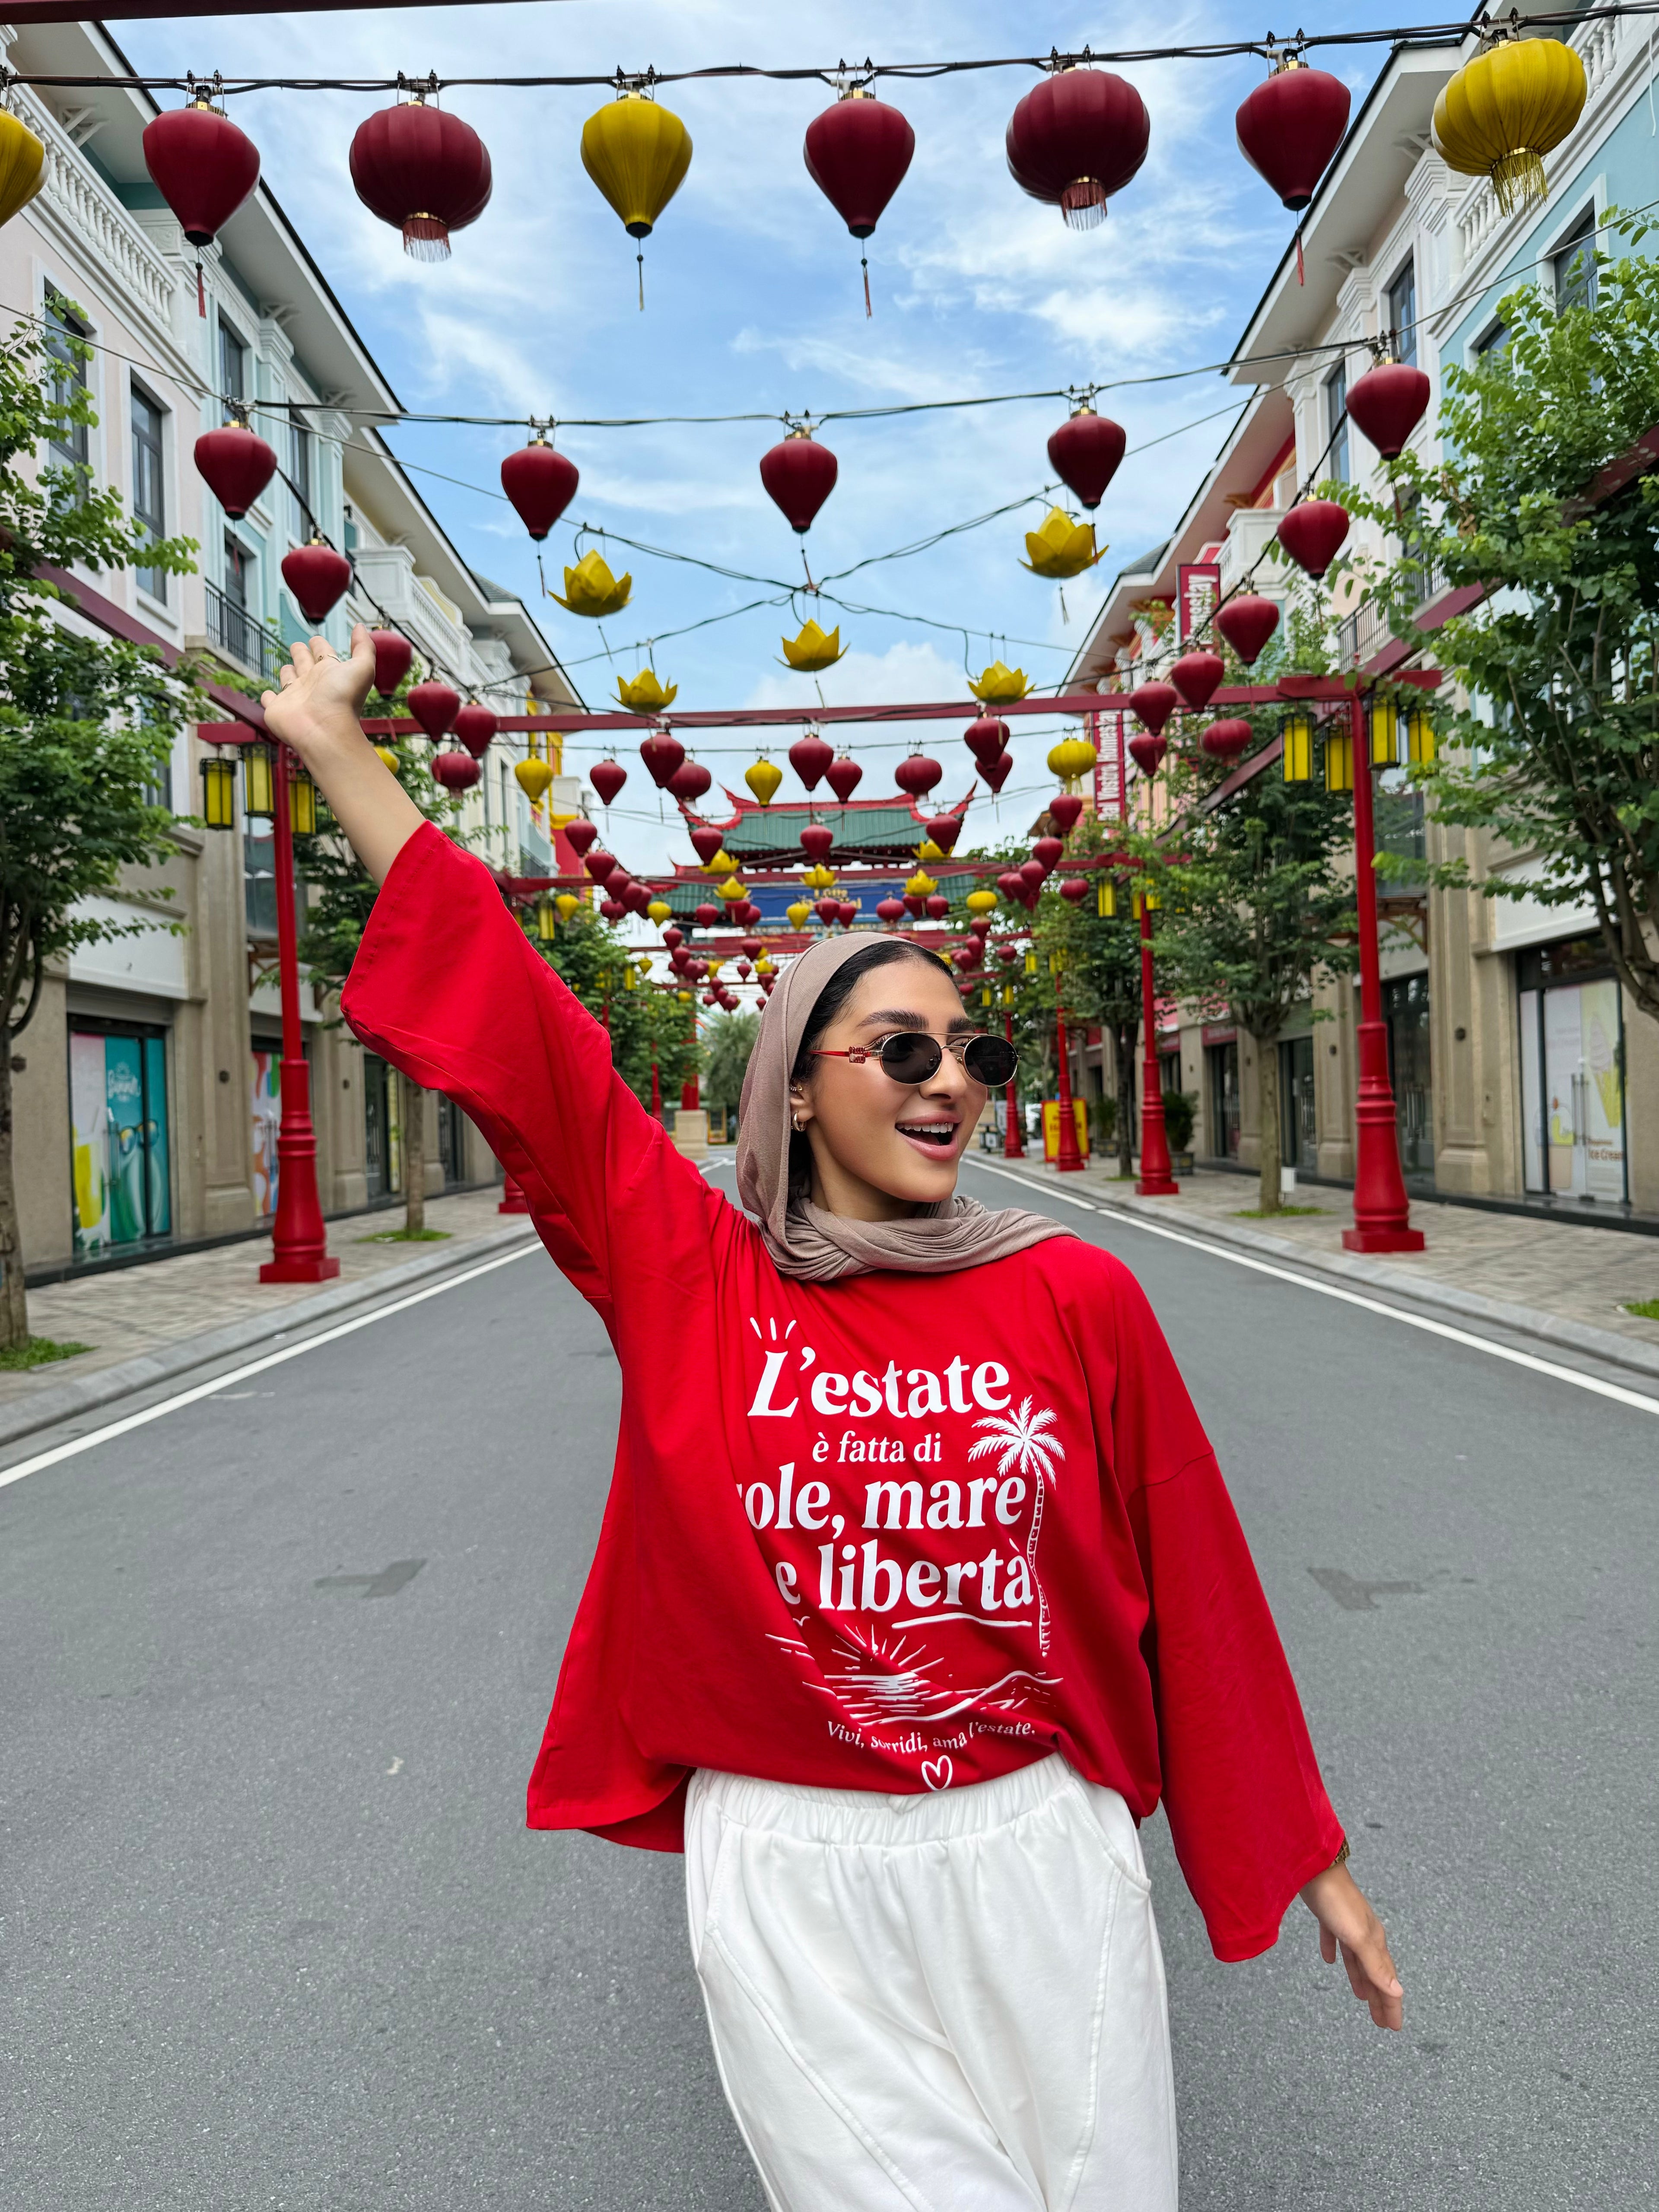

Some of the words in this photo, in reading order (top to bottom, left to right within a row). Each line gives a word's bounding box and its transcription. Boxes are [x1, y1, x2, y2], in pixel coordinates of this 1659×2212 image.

[1095, 709, 1121, 763] Homestay
[1097, 764, 1120, 801] Vostro
[747, 1346, 1011, 1418] L'estate
[812, 1432, 829, 1462] è
[837, 1430, 906, 1463] fatta
[913, 1432, 942, 1462] di
[736, 1462, 845, 1539] ole,
[861, 1478, 1026, 1529] mare
[775, 1561, 801, 1605] e
[818, 1538, 1034, 1612] libertà
[827, 1720, 864, 1748] Vivi,
[933, 1732, 967, 1749] ama
[969, 1721, 1035, 1738] l'estate.
